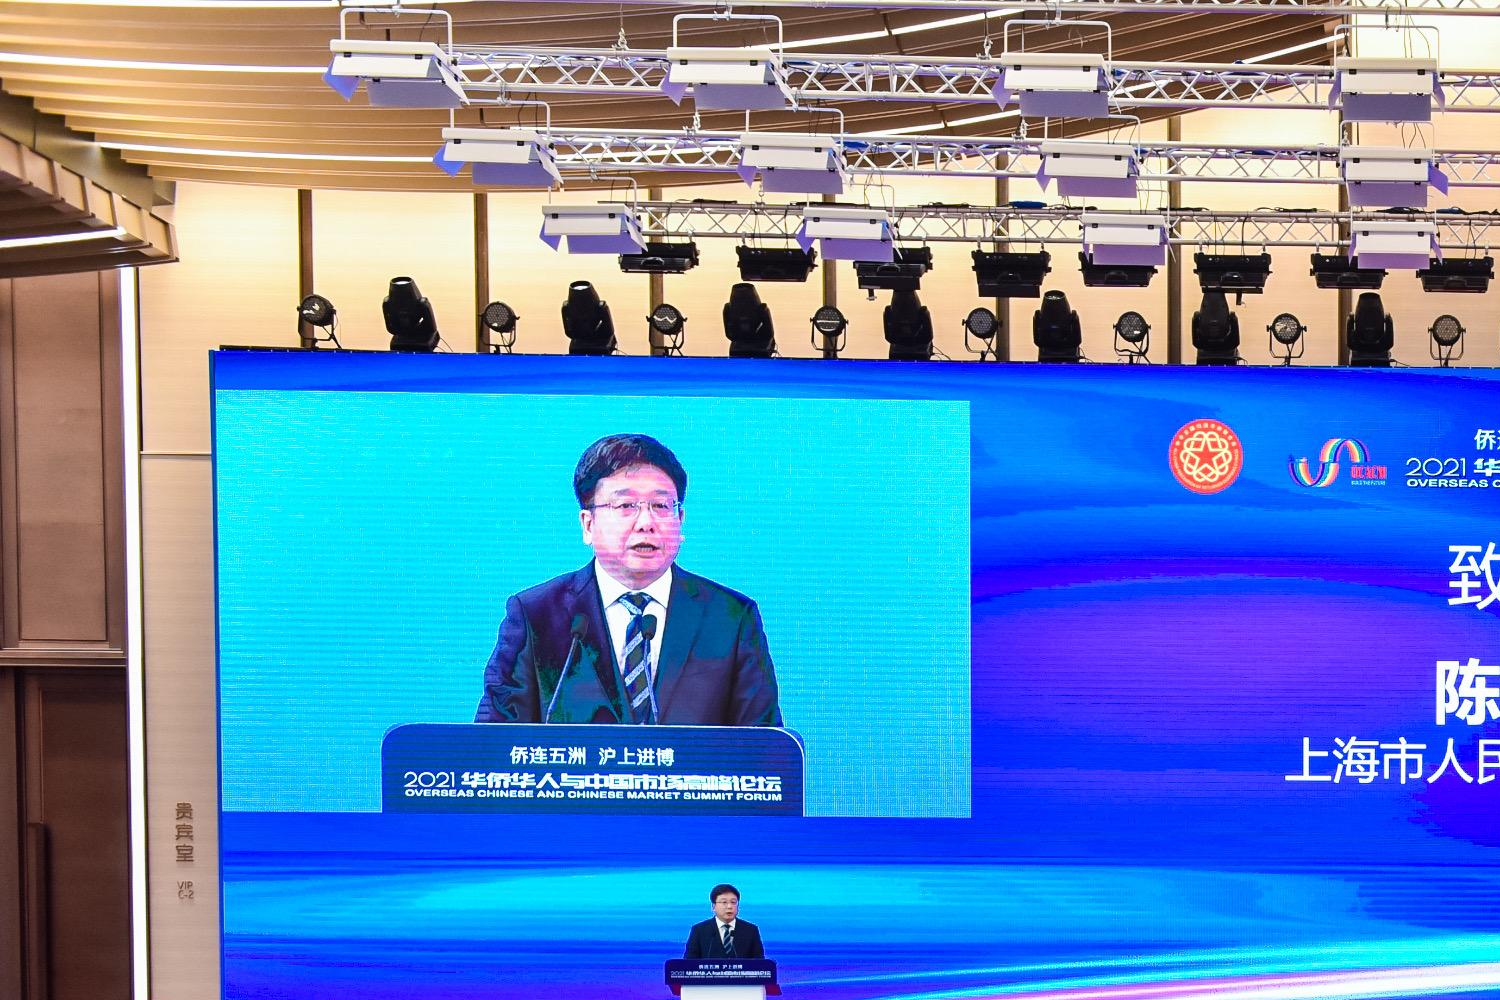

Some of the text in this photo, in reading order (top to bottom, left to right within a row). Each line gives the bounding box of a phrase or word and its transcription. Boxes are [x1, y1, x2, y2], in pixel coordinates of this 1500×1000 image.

[1405, 457, 1466, 477] 2021
[1406, 479, 1489, 488] OVERSEAS
[510, 746, 675, 766] 侨连五洲 沪上进博
[403, 771, 782, 792] 2021 华侨华人与中国市场高峰论坛
[405, 789, 782, 801] OVERSEAS CHINESE AND CHINESE MARKET SUMMIT FORUM
[177, 881, 193, 889] VIP
